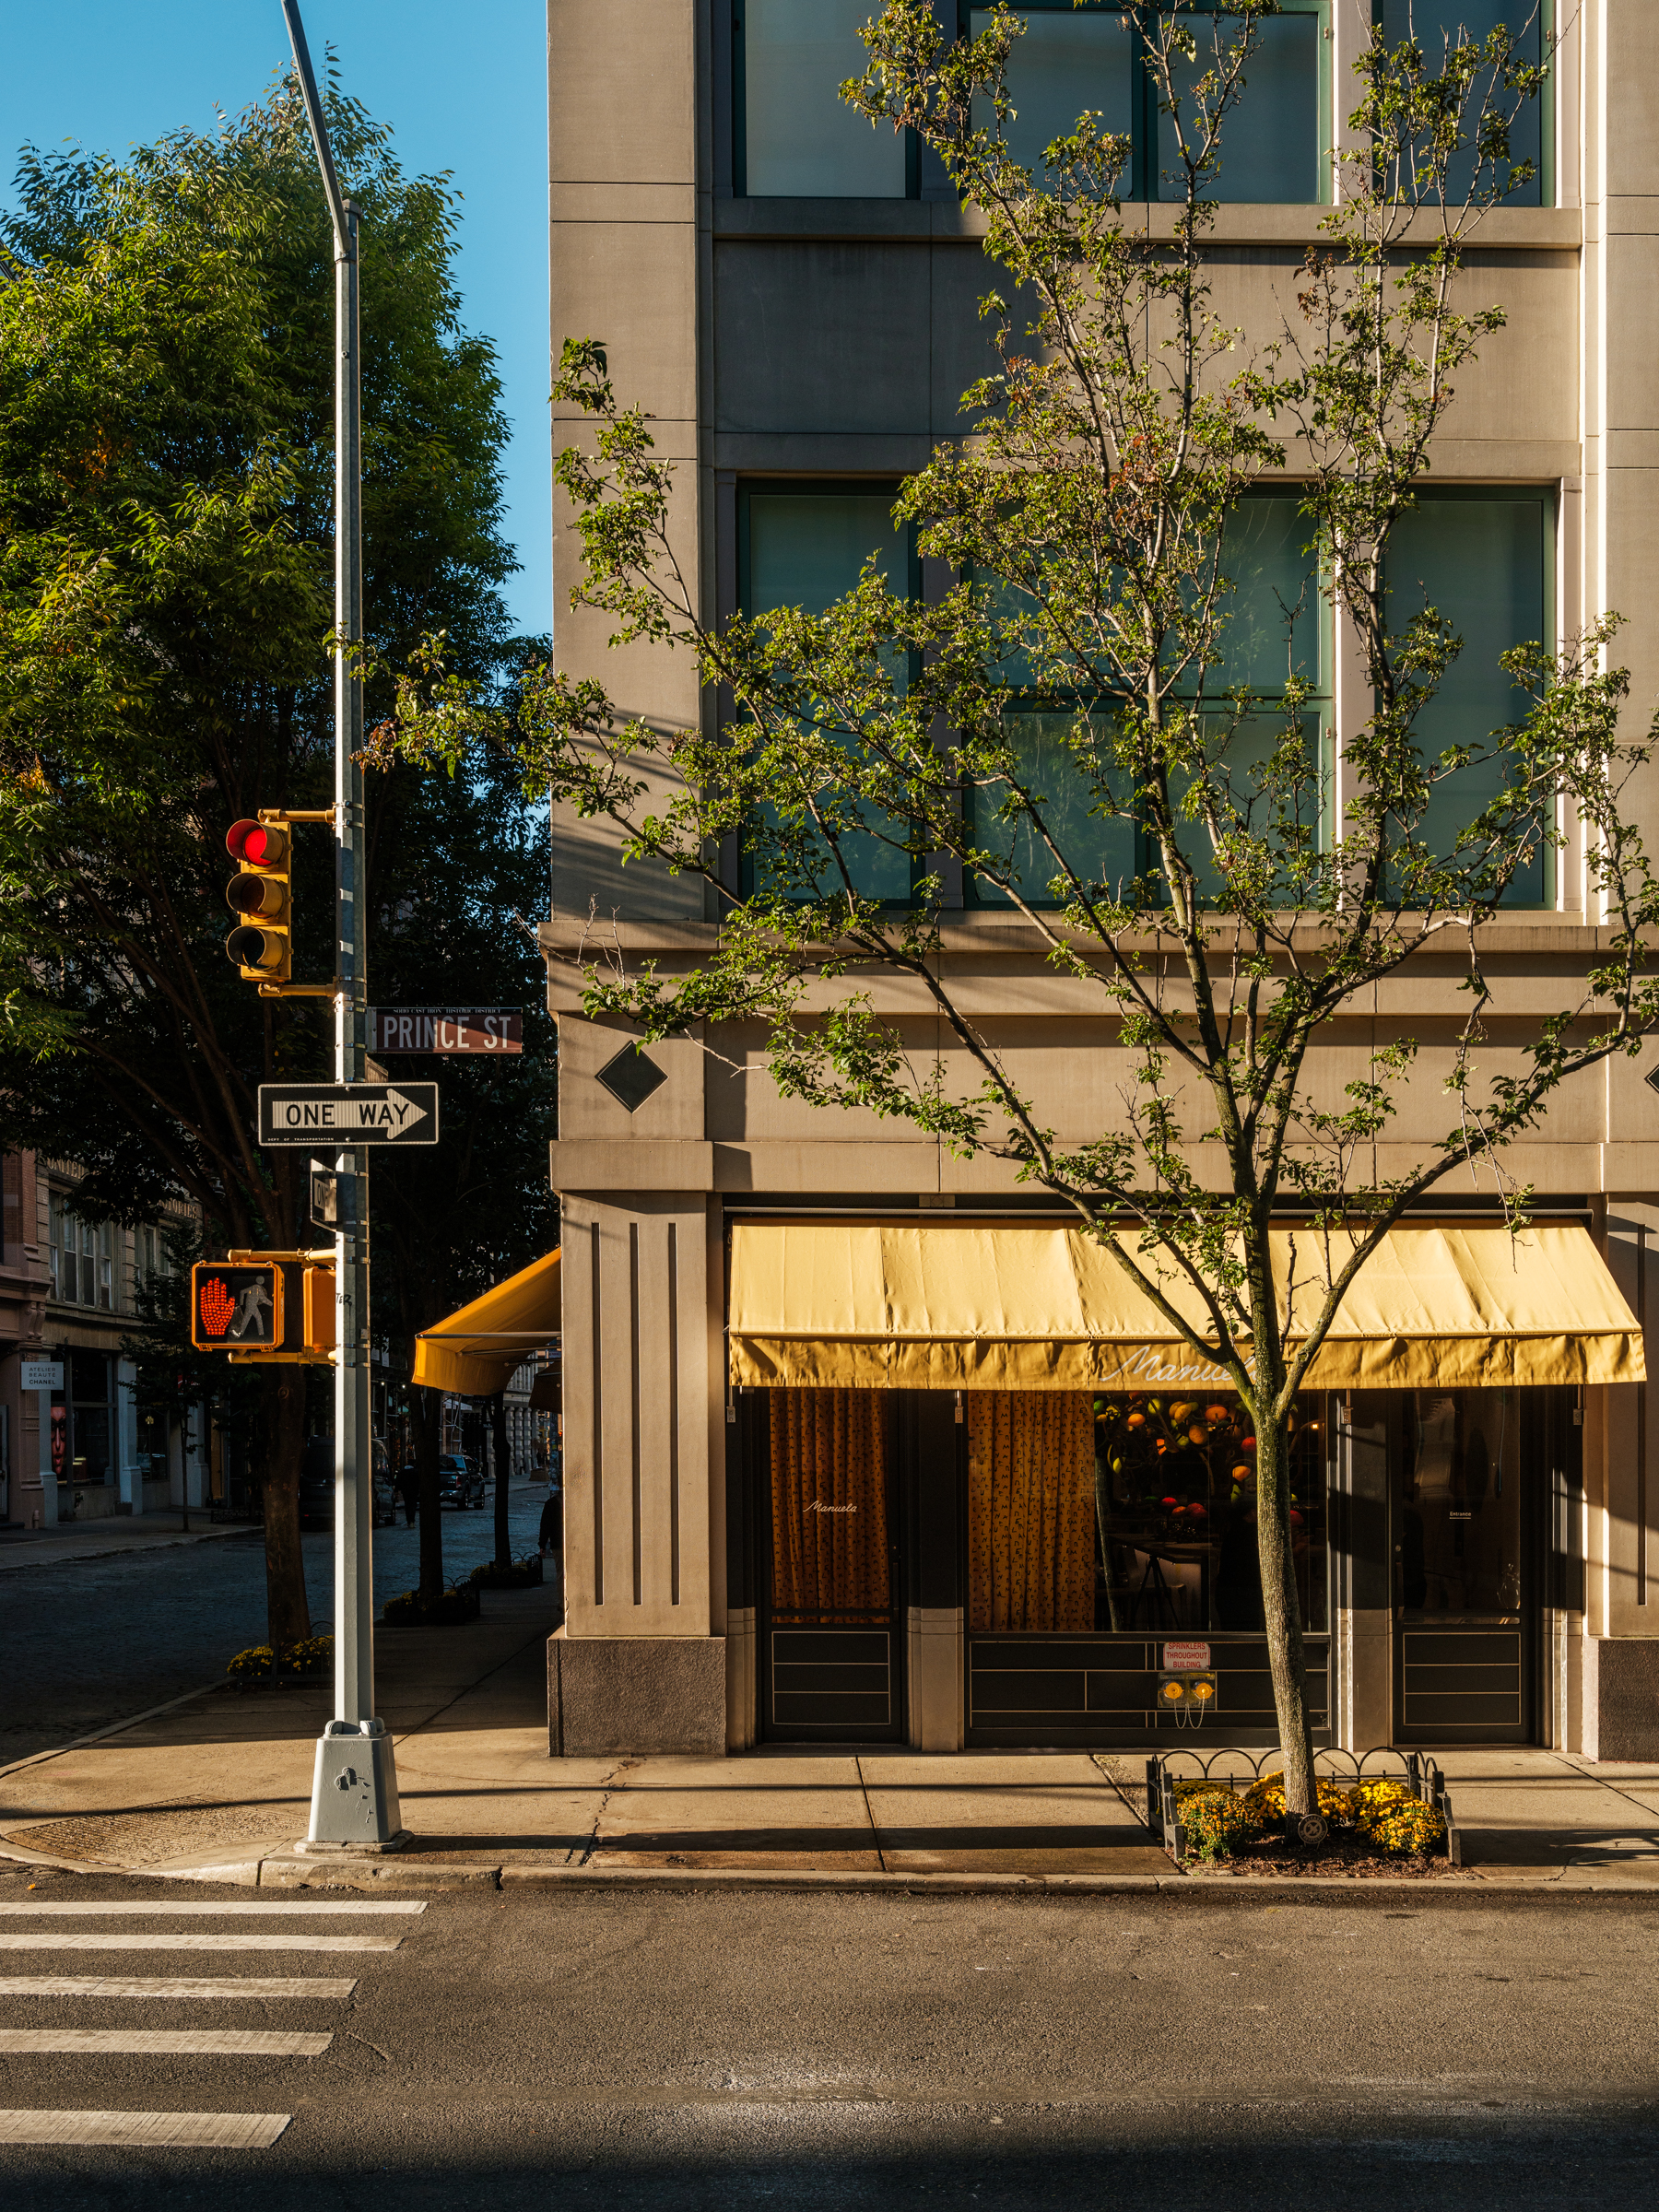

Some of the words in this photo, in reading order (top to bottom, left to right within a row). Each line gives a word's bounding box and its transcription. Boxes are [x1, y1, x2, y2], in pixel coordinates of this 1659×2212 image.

[383, 1016, 469, 1048] PRINCE
[484, 1015, 511, 1049] ST
[286, 1104, 335, 1125] ONE
[359, 1103, 409, 1125] WAY
[802, 1500, 857, 1512] Manuela
[1168, 1641, 1206, 1650] SPRINKLERS
